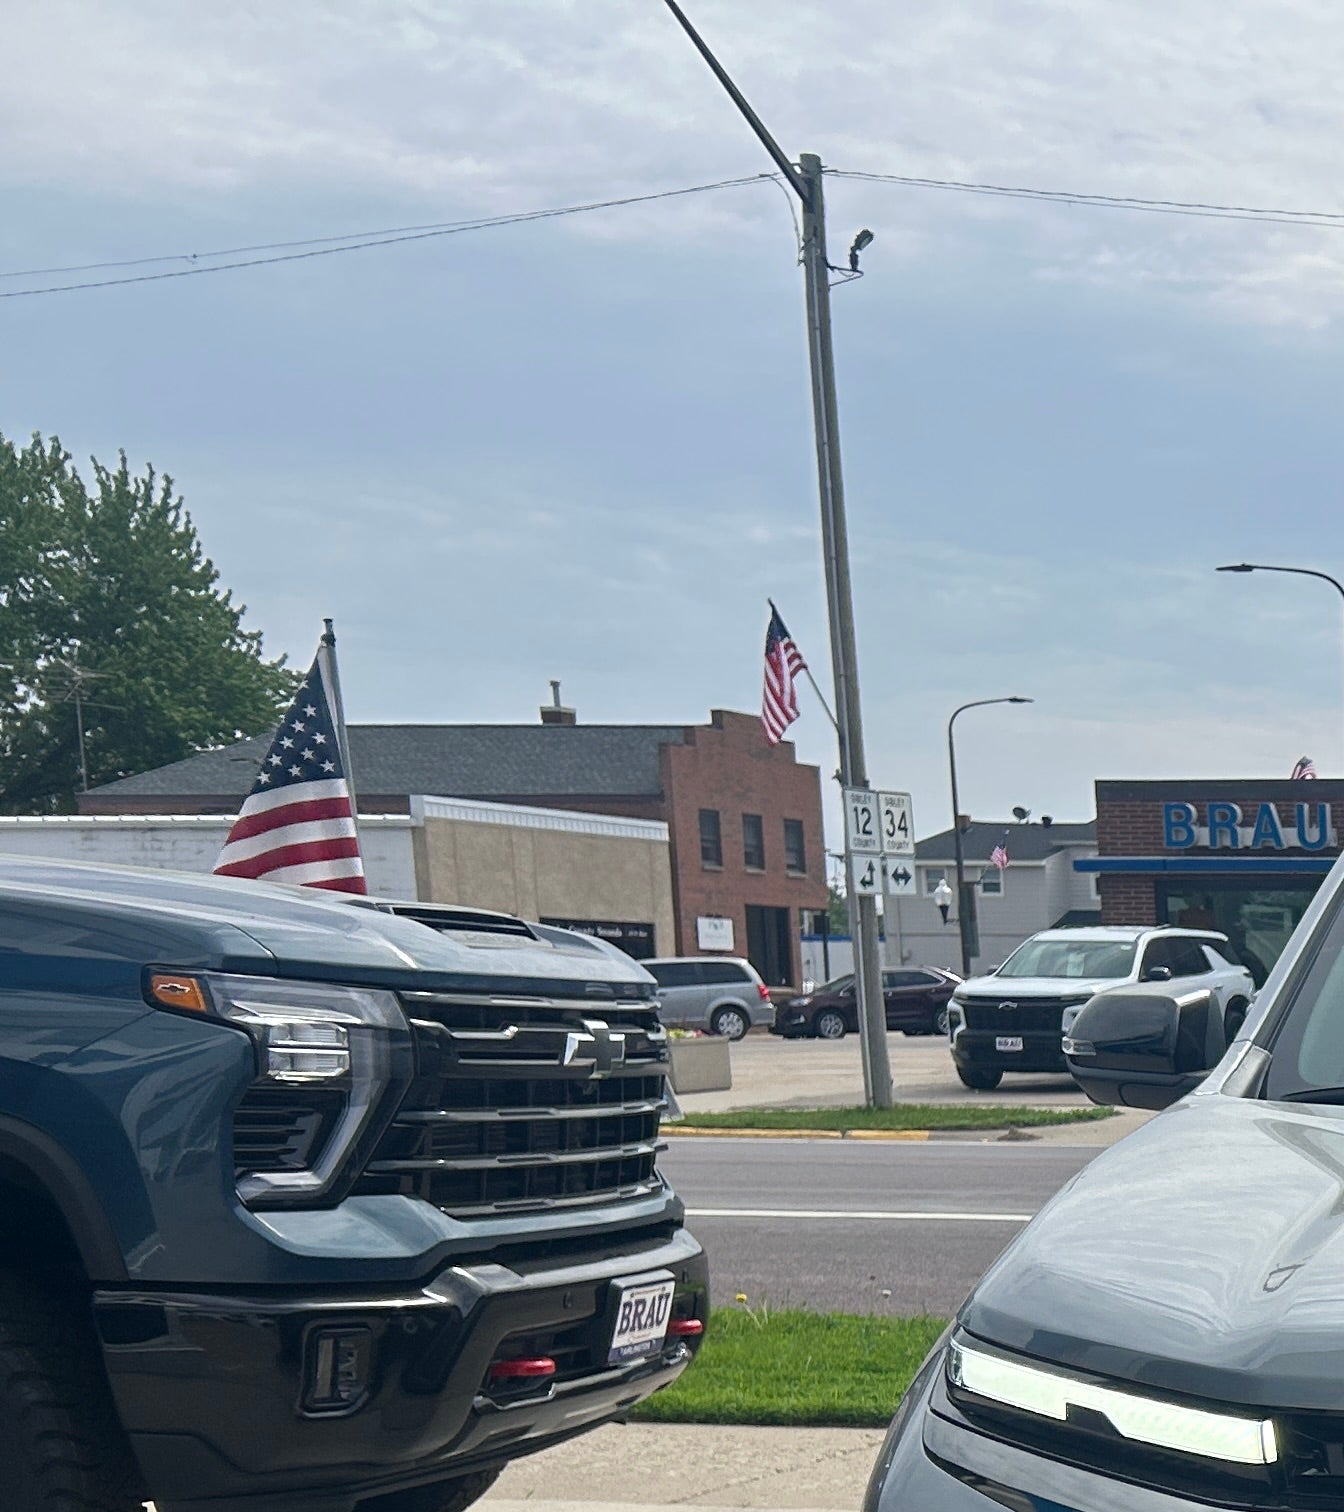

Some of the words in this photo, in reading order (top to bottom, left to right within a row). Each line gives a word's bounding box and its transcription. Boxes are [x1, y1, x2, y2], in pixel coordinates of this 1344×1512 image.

[854, 806, 873, 835] 12
[885, 809, 908, 838] 34
[1163, 802, 1333, 850] BRAU
[617, 1293, 671, 1336] BRAU
